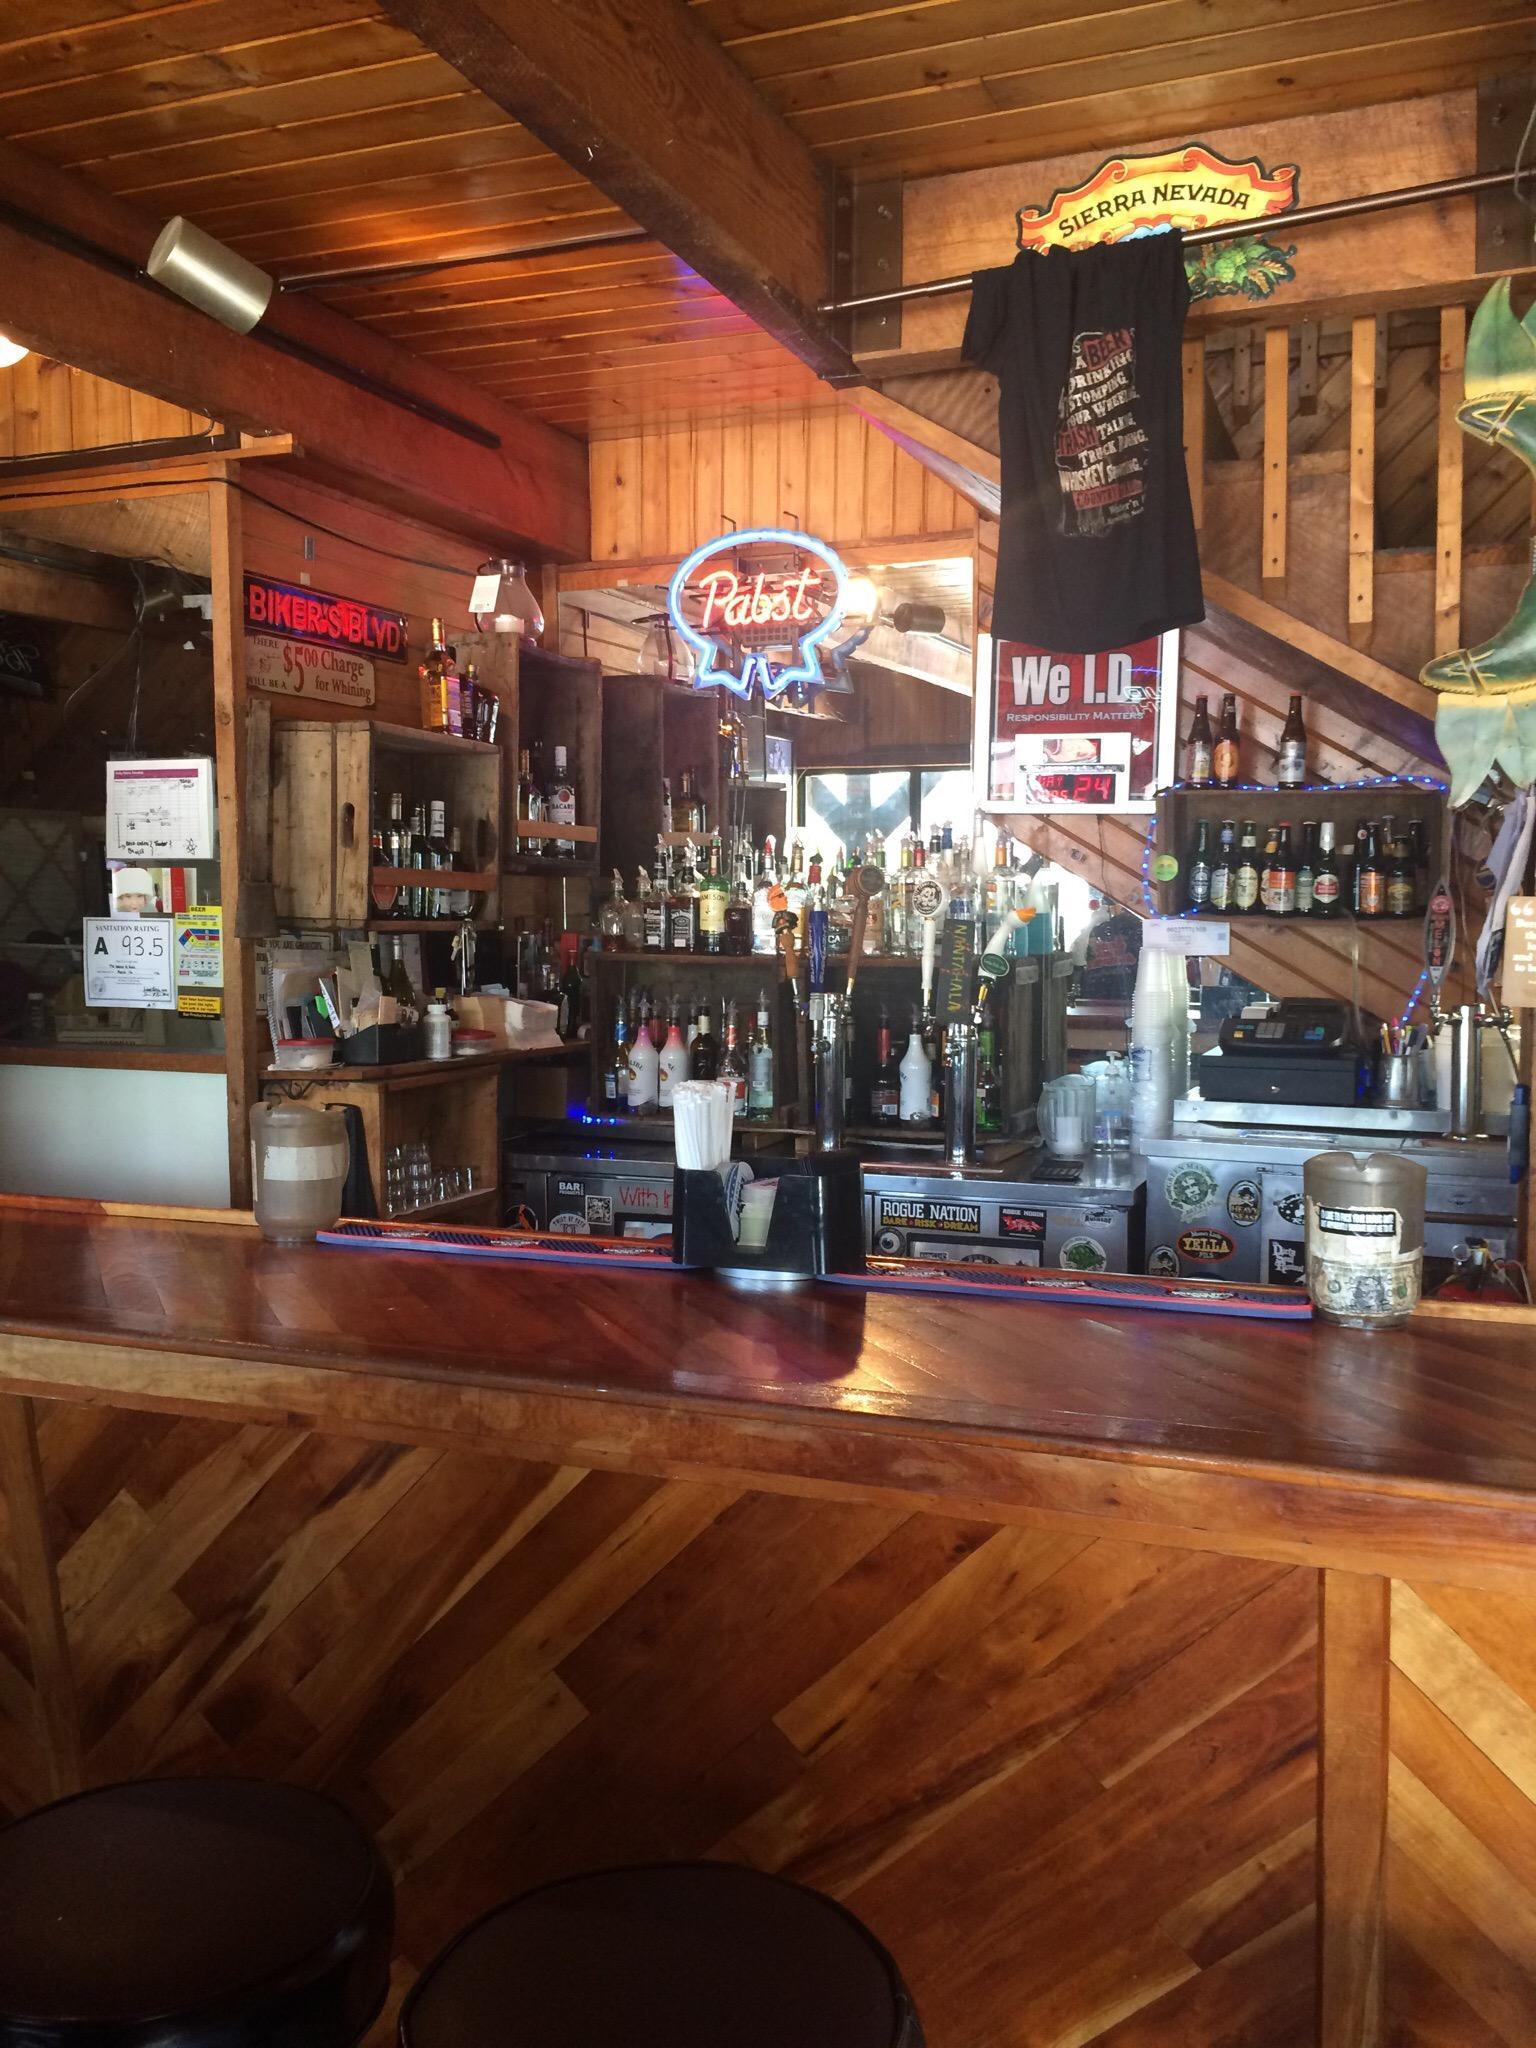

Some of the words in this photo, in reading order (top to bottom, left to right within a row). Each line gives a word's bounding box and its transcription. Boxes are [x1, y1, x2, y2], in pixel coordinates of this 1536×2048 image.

[1058, 189, 1146, 238] SIERRA
[1152, 182, 1250, 210] NEVADA
[698, 568, 821, 629] Pabst
[349, 606, 401, 653] BLVD
[321, 649, 365, 681] Charge
[315, 675, 329, 691] for
[332, 678, 372, 704] Whining
[1011, 655, 1071, 706] We
[1006, 712, 1090, 722] RESPONSIBILITY
[1093, 711, 1144, 721] MATTERS
[1073, 777, 1112, 802] 24
[701, 893, 725, 903] AMESON
[137, 924, 160, 933] RATING
[94, 936, 109, 955] A
[121, 935, 164, 957] 93.5
[559, 1182, 581, 1191] BAR
[883, 1201, 924, 1218] ROGUE
[930, 1204, 978, 1222] NATION
[943, 1221, 978, 1231] DREAM
[1182, 1237, 1230, 1253] YELLA
